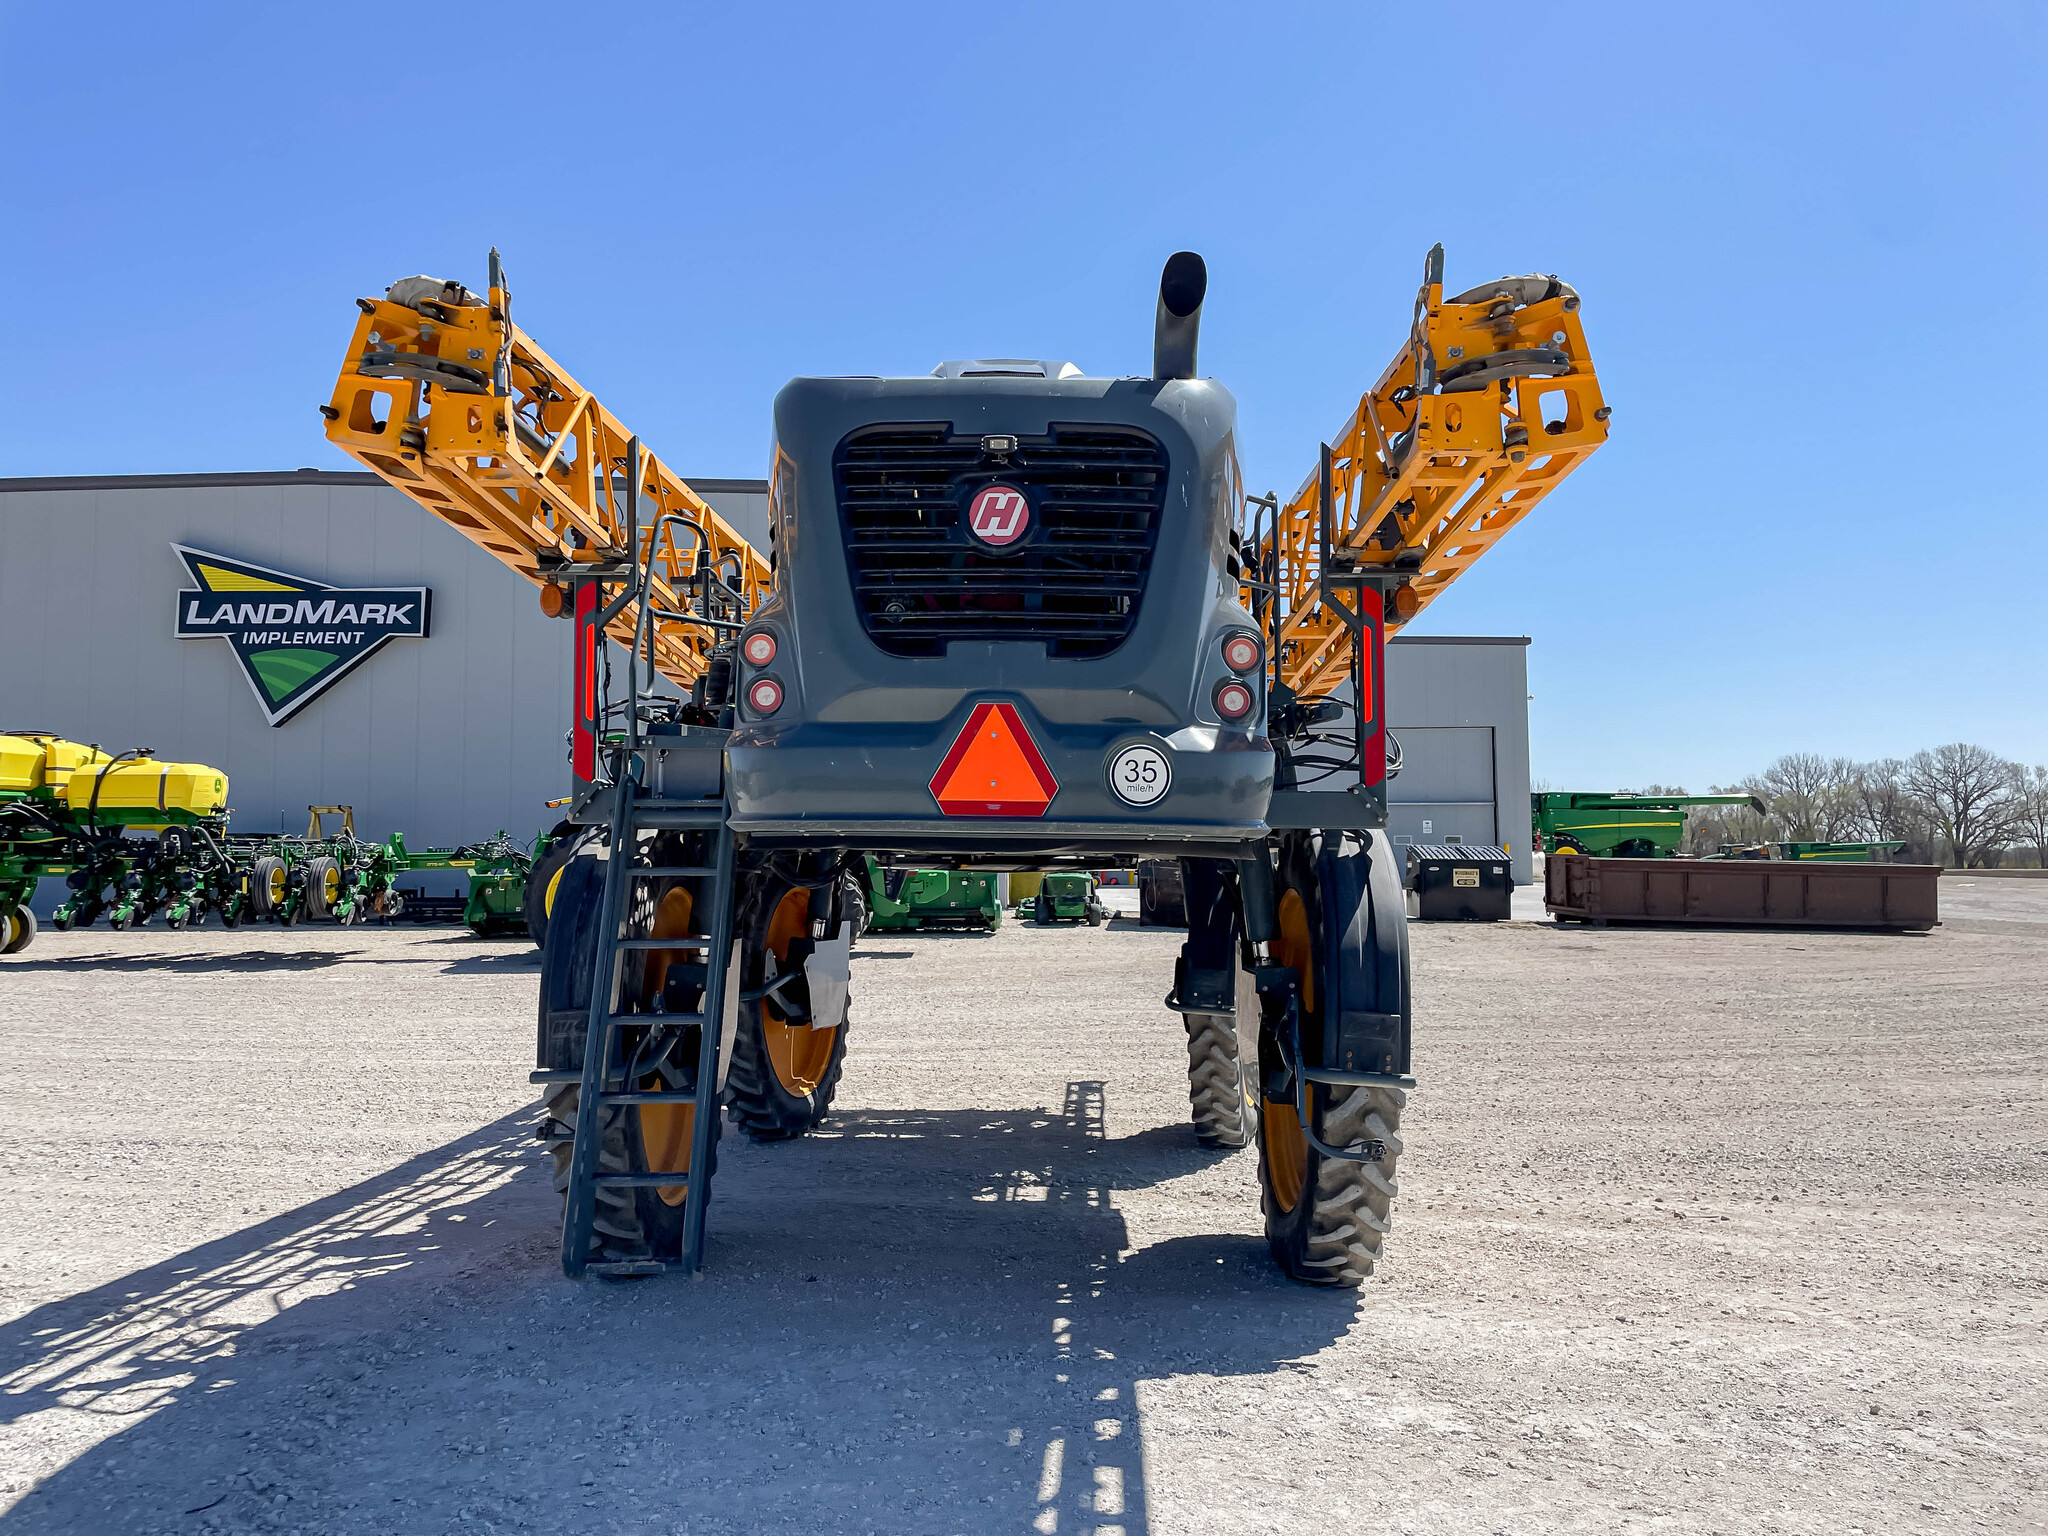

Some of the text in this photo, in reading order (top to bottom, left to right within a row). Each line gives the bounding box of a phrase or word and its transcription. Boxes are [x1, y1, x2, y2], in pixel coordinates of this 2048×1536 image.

[973, 493, 1025, 536] H
[185, 600, 415, 624] LANDMARK
[242, 631, 365, 644] IMPLEMENT
[1124, 759, 1157, 783] 35
[1126, 784, 1154, 793] mile/h
